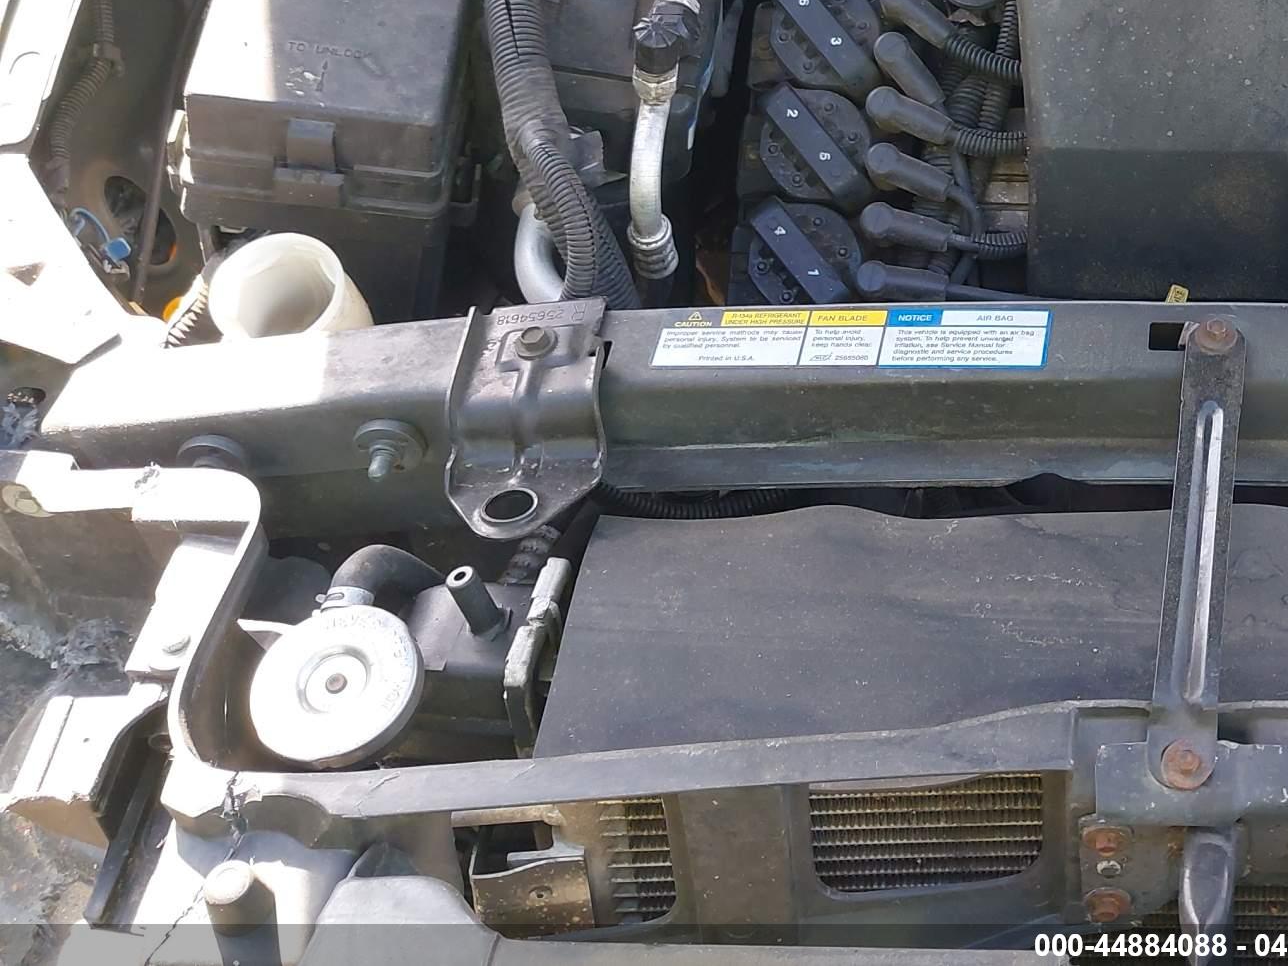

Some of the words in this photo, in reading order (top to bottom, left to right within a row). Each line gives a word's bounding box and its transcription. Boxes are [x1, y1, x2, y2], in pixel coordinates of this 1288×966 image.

[287, 41, 306, 52] TO
[830, 37, 842, 46] 3
[786, 108, 799, 118] 2
[773, 225, 786, 236] 4
[571, 302, 587, 322] R
[897, 314, 933, 322] NOTICE
